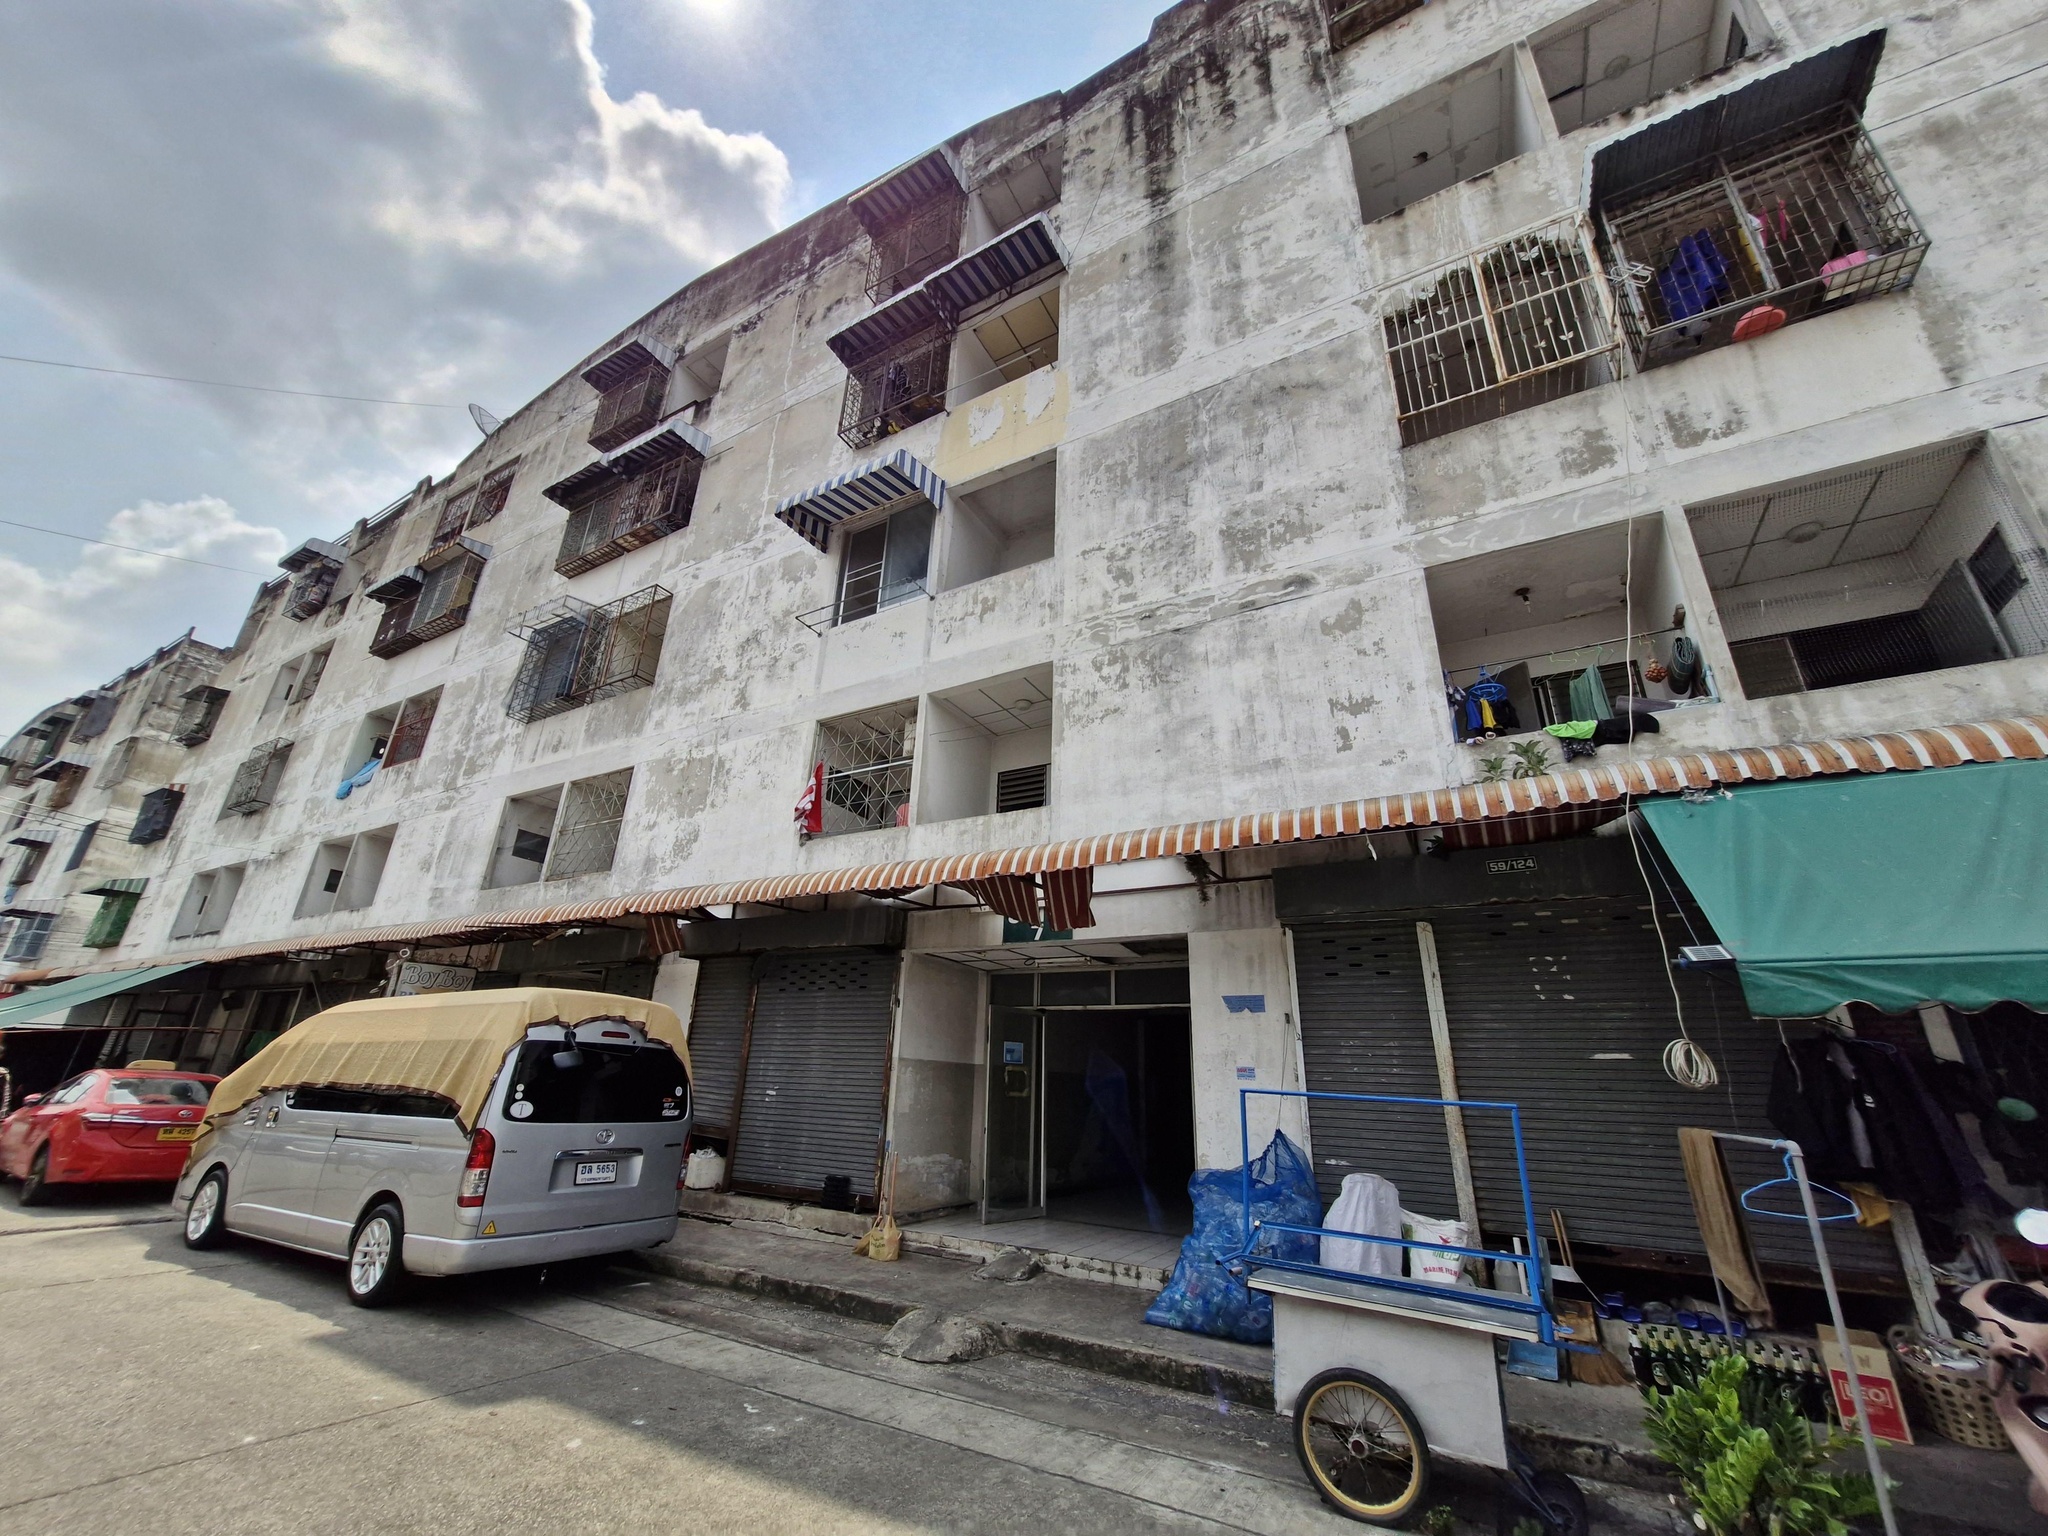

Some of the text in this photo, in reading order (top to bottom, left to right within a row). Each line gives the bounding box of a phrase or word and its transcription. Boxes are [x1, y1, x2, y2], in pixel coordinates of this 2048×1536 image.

[1489, 859, 1535, 871] 59/124
[518, 1103, 527, 1116] T
[596, 1164, 615, 1174] 5653
